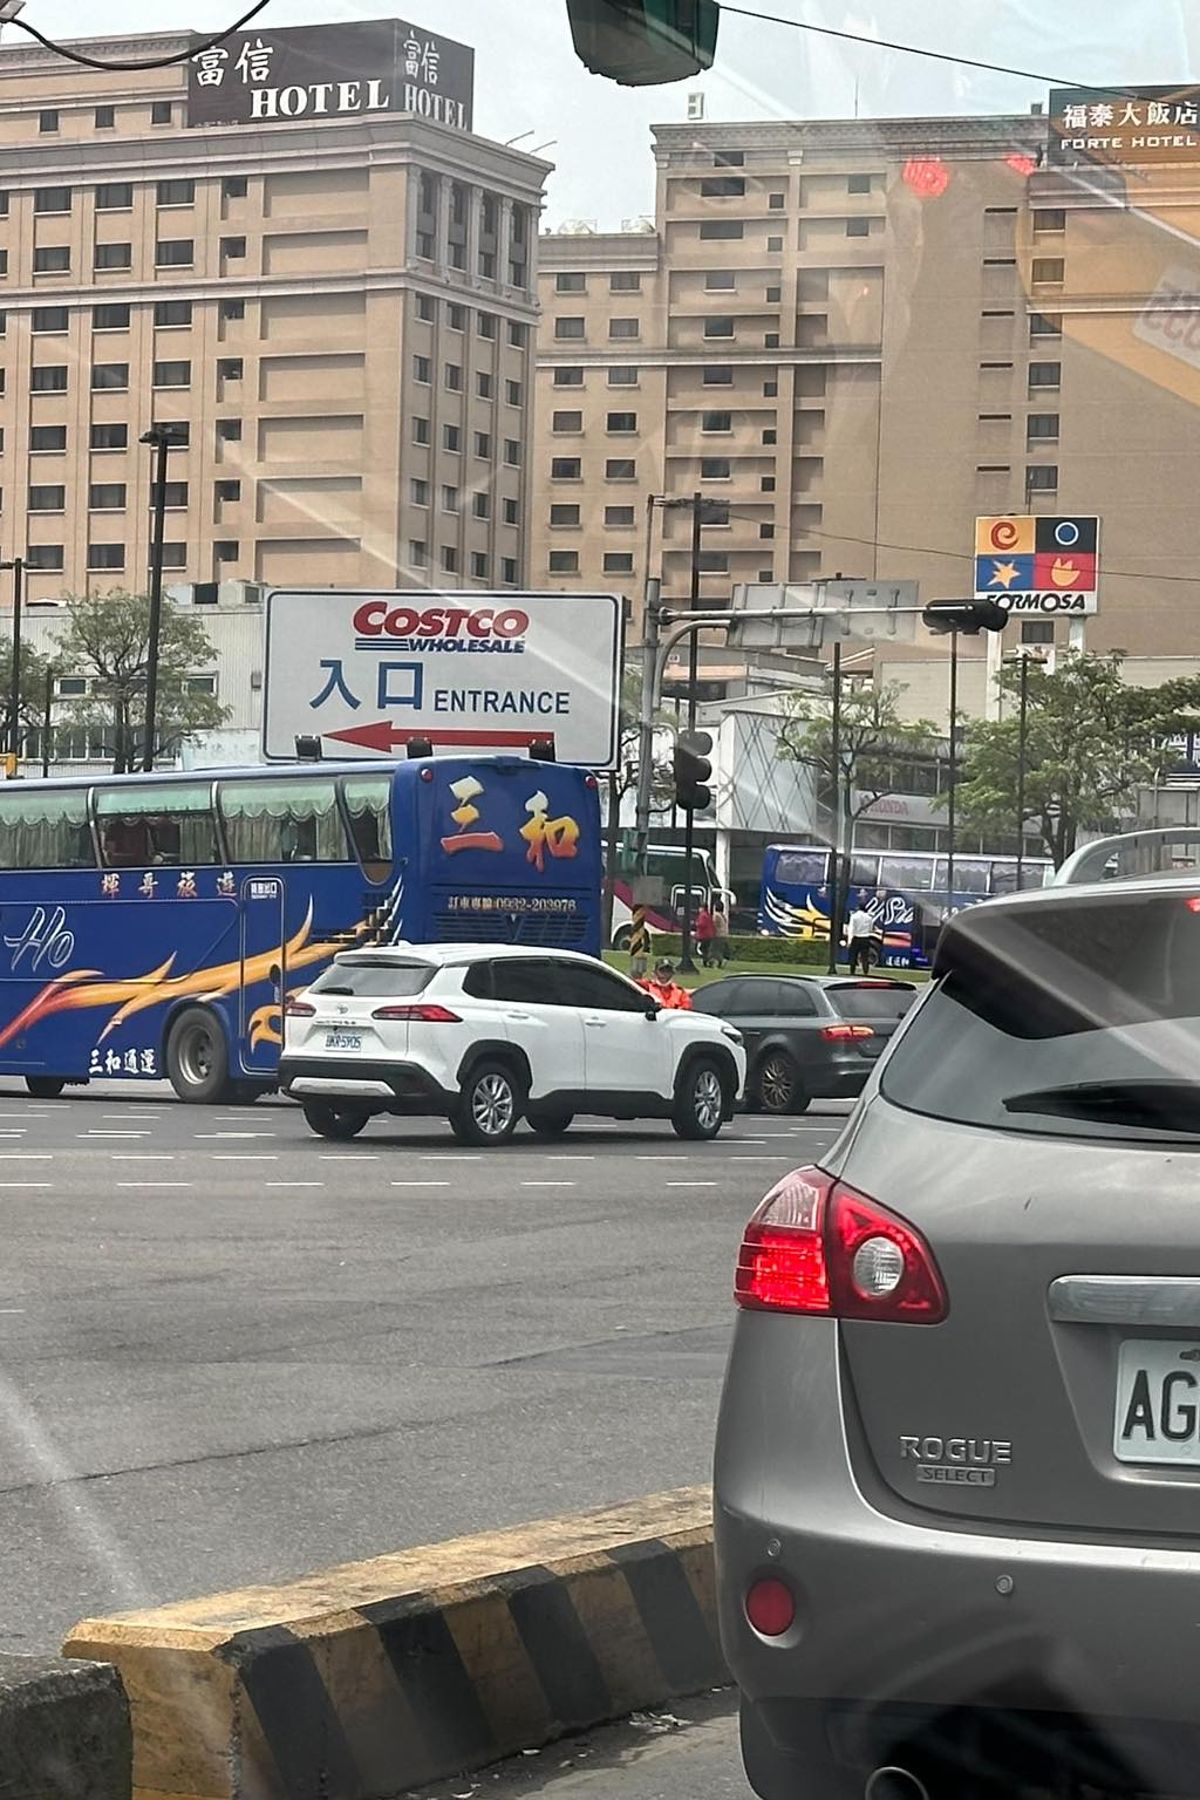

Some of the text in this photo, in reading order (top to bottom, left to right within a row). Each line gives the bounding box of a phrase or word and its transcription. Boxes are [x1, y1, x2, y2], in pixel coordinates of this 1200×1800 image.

[191, 38, 274, 88] 富信
[403, 30, 440, 86] 富信
[250, 79, 390, 119] HOTEL
[403, 83, 468, 131] HOTEL
[1062, 101, 1198, 129] 福泰大飯店
[1061, 135, 1198, 150] FORTE HOTEL
[352, 601, 530, 638] COSTCO
[408, 638, 526, 654] WHOLESALE
[309, 659, 425, 711] 入口
[434, 690, 570, 714] ENTRANCE
[440, 775, 580, 872] 三和
[4, 906, 74, 972] Ho
[1121, 1369, 1200, 1441] AG
[900, 1436, 1012, 1464] ROGUE
[923, 1467, 989, 1483] SELECT
